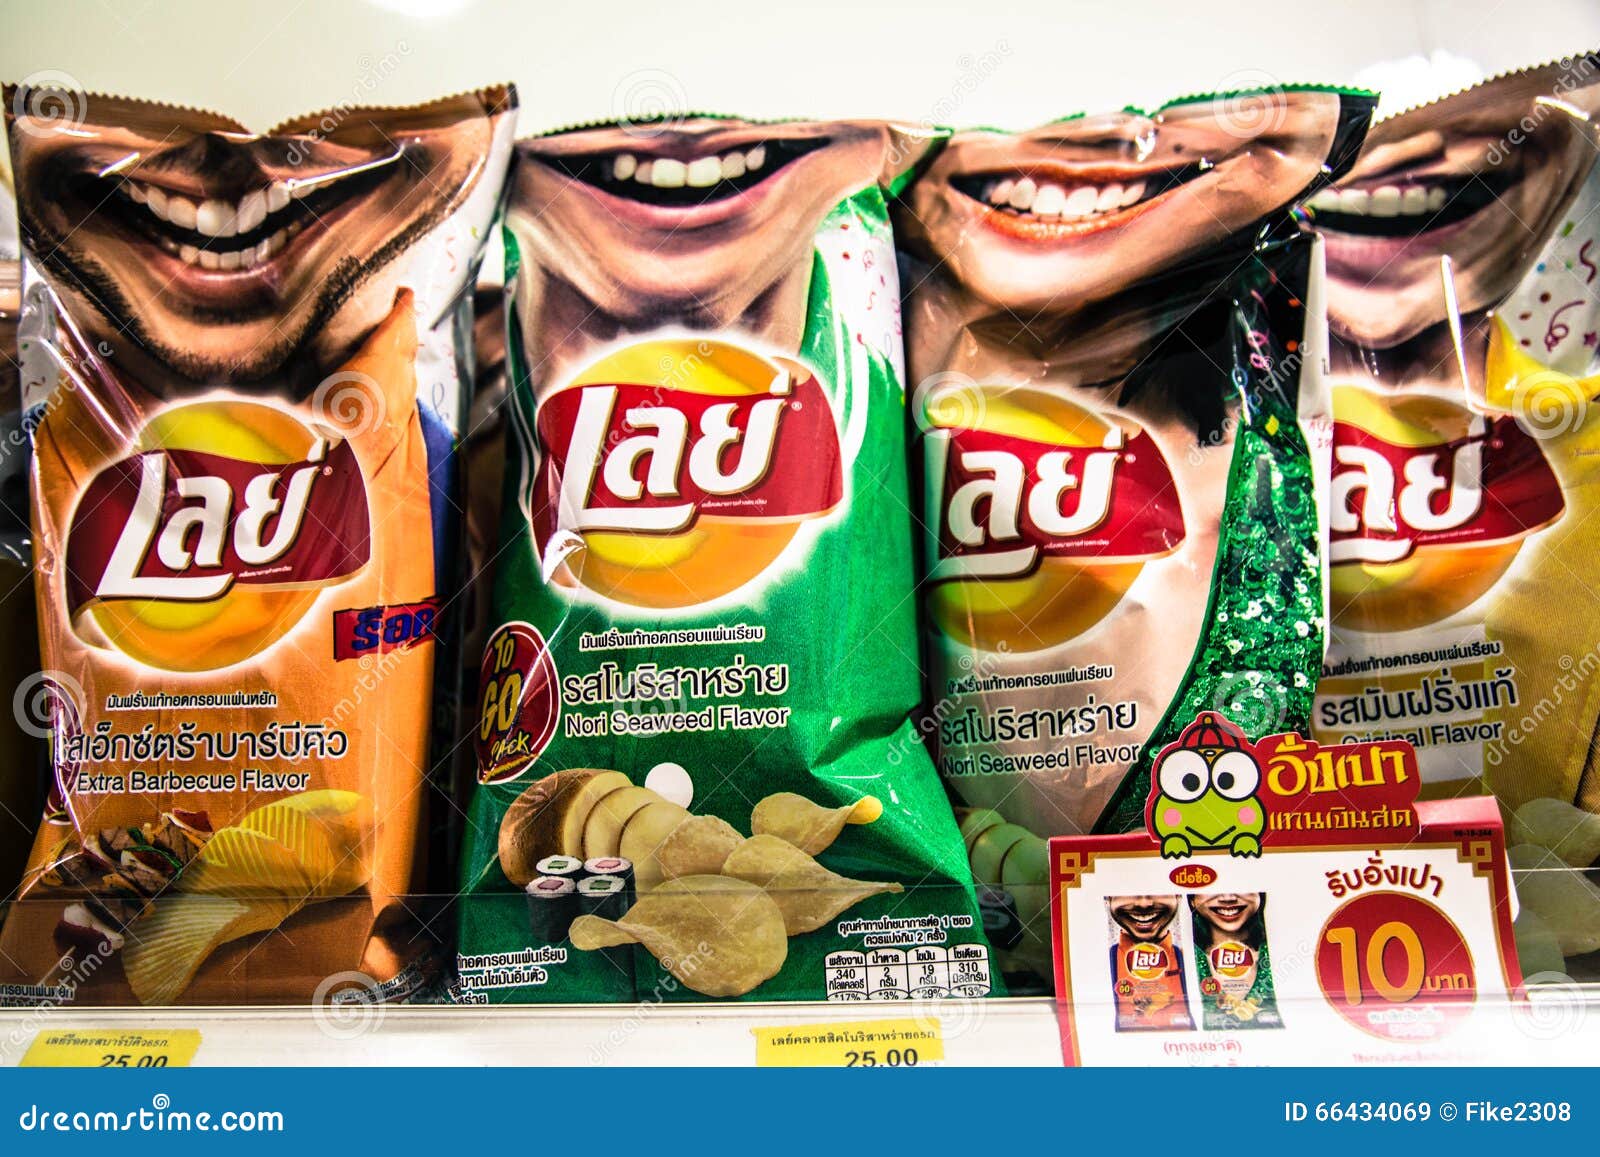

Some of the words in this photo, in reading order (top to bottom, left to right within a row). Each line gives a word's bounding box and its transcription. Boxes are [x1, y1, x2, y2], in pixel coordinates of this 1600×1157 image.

[494, 631, 515, 674] TO
[564, 656, 787, 702] รสโนริสาหร่าย
[481, 673, 521, 741] GO
[1321, 668, 1517, 726] รสมันฝรั่งแท้
[566, 713, 606, 735] Nori
[613, 708, 713, 732] Seaweed
[720, 706, 789, 728] Flavor
[942, 696, 1137, 745] รสโนริสาหร่าย
[1432, 721, 1502, 745] Flavor
[63, 722, 347, 762] สเอ็กซ์ตร้าบาร์บีคิว
[943, 753, 974, 776] Nori
[980, 748, 1069, 772] Seaweed
[1076, 743, 1140, 766] Flavor
[1267, 734, 1409, 796] อั่งเปา
[77, 774, 124, 791] Extra
[131, 771, 235, 791] Barbecue
[242, 770, 309, 790] Flavor
[1269, 805, 1413, 831] แทนเงินสด
[1325, 850, 1444, 898] รับอั่งเปา
[942, 917, 948, 926] 1
[917, 932, 923, 942] 2
[836, 969, 856, 979] 340
[883, 967, 890, 977] 2
[922, 964, 934, 975] 19
[958, 961, 978, 973] 310
[1326, 921, 1425, 1006] 10
[1426, 972, 1469, 992] บาท
[845, 1048, 919, 1067] 25.00
